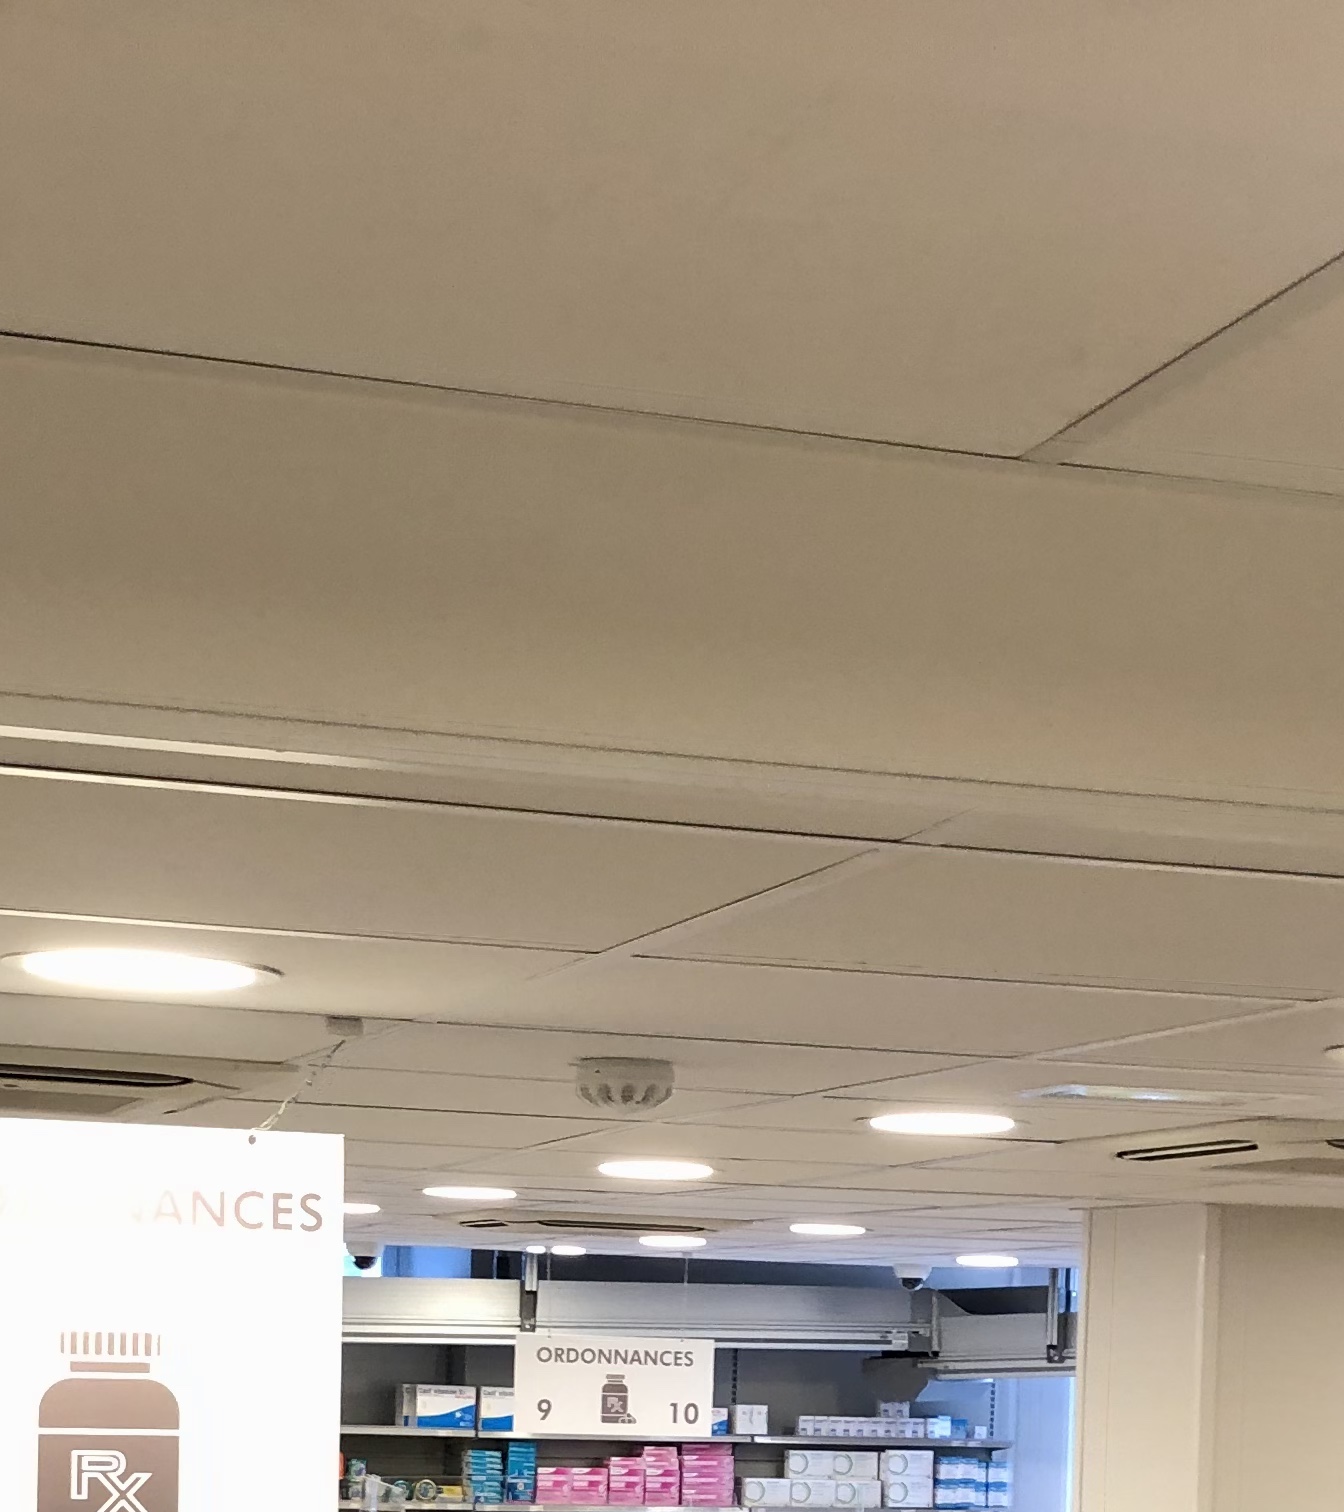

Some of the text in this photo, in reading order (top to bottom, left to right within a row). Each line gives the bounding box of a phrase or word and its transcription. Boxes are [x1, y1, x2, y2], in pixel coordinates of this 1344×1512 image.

[537, 1347, 694, 1367] ORDONNANCES
[537, 1399, 552, 1420] 9
[669, 1402, 699, 1424] 10
